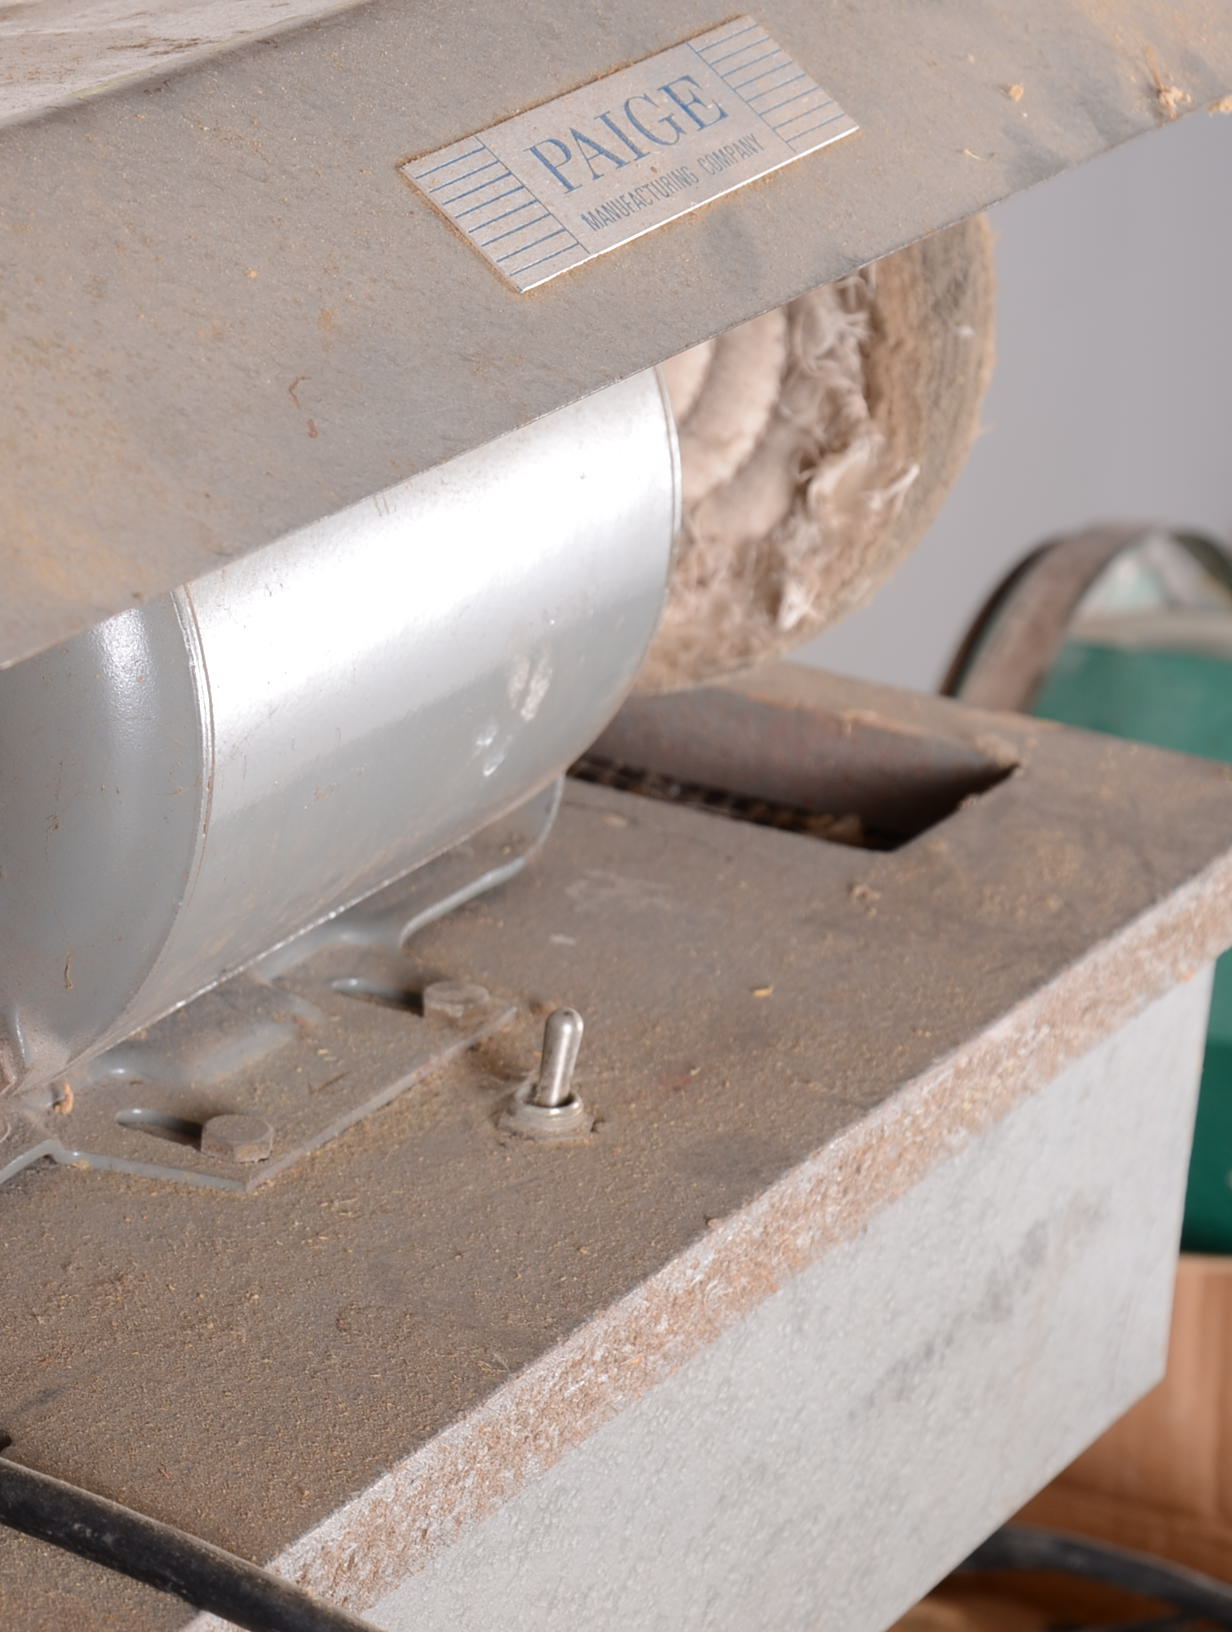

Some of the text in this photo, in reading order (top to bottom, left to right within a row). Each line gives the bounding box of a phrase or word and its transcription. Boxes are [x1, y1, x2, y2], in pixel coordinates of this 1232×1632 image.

[523, 74, 729, 194] PAIGE
[580, 132, 765, 232] MANUFACTURING COMPANY
